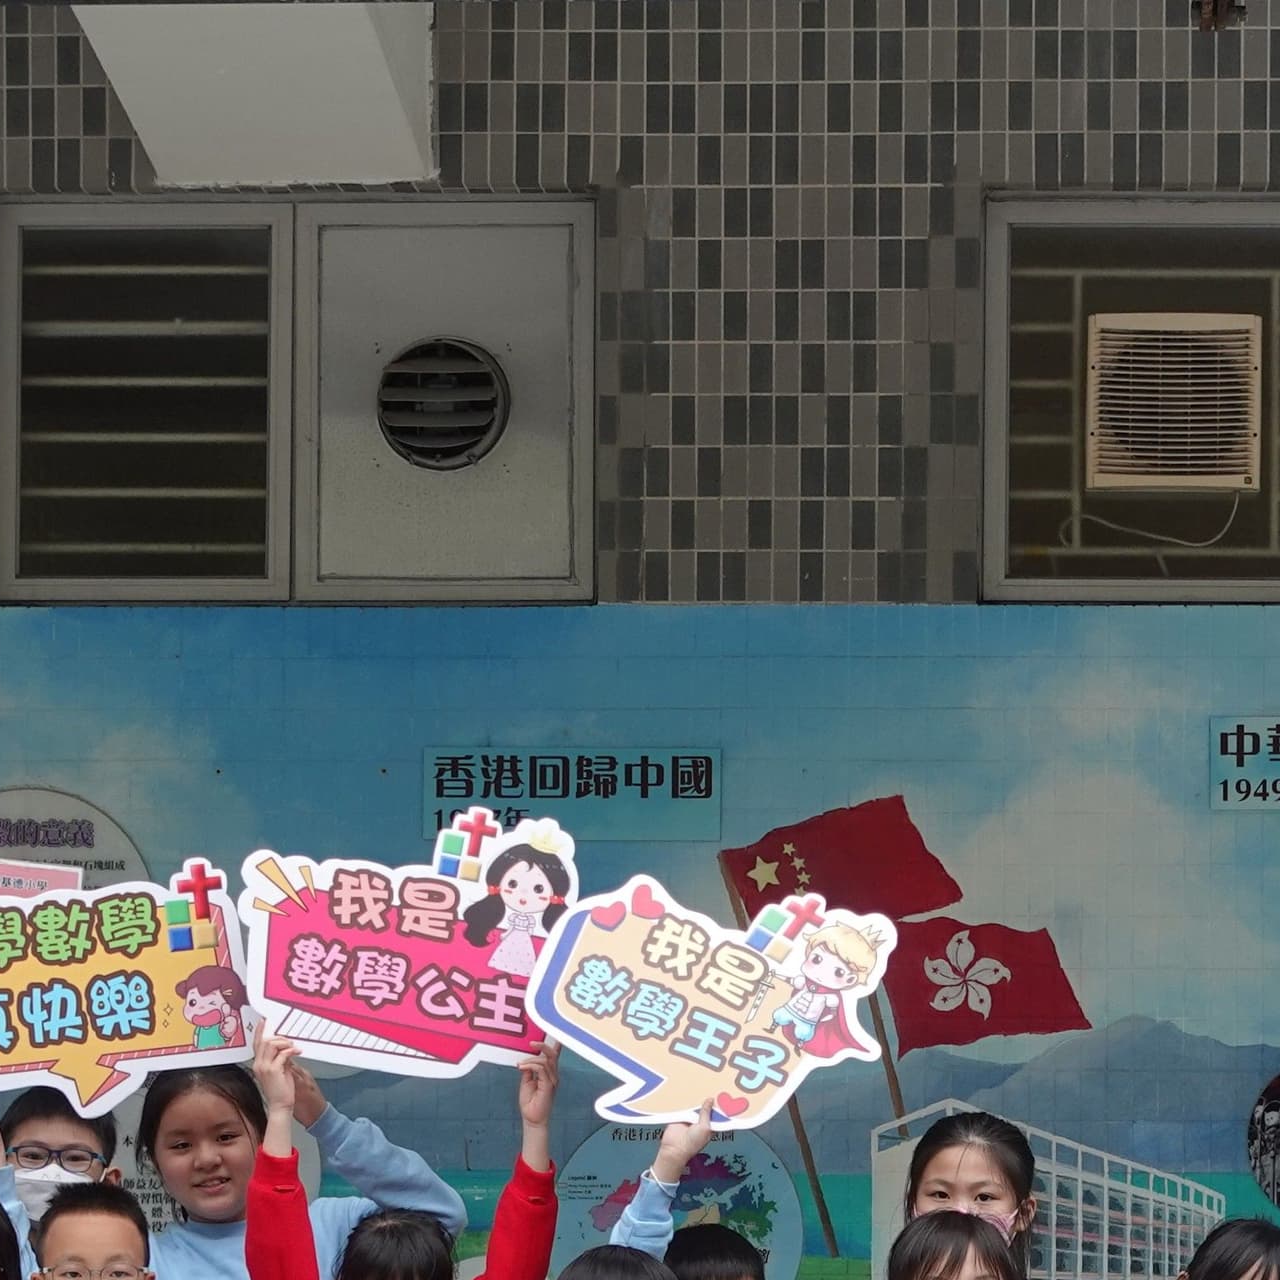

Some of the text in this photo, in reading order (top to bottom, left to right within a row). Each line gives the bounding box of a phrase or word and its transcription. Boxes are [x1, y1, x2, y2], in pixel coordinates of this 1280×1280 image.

[433, 754, 713, 799] 香港回歸中國
[331, 867, 459, 941] 我是
[284, 934, 528, 1037] 數學公主
[645, 915, 772, 1011] 我是
[566, 955, 792, 1096] 數學王子
